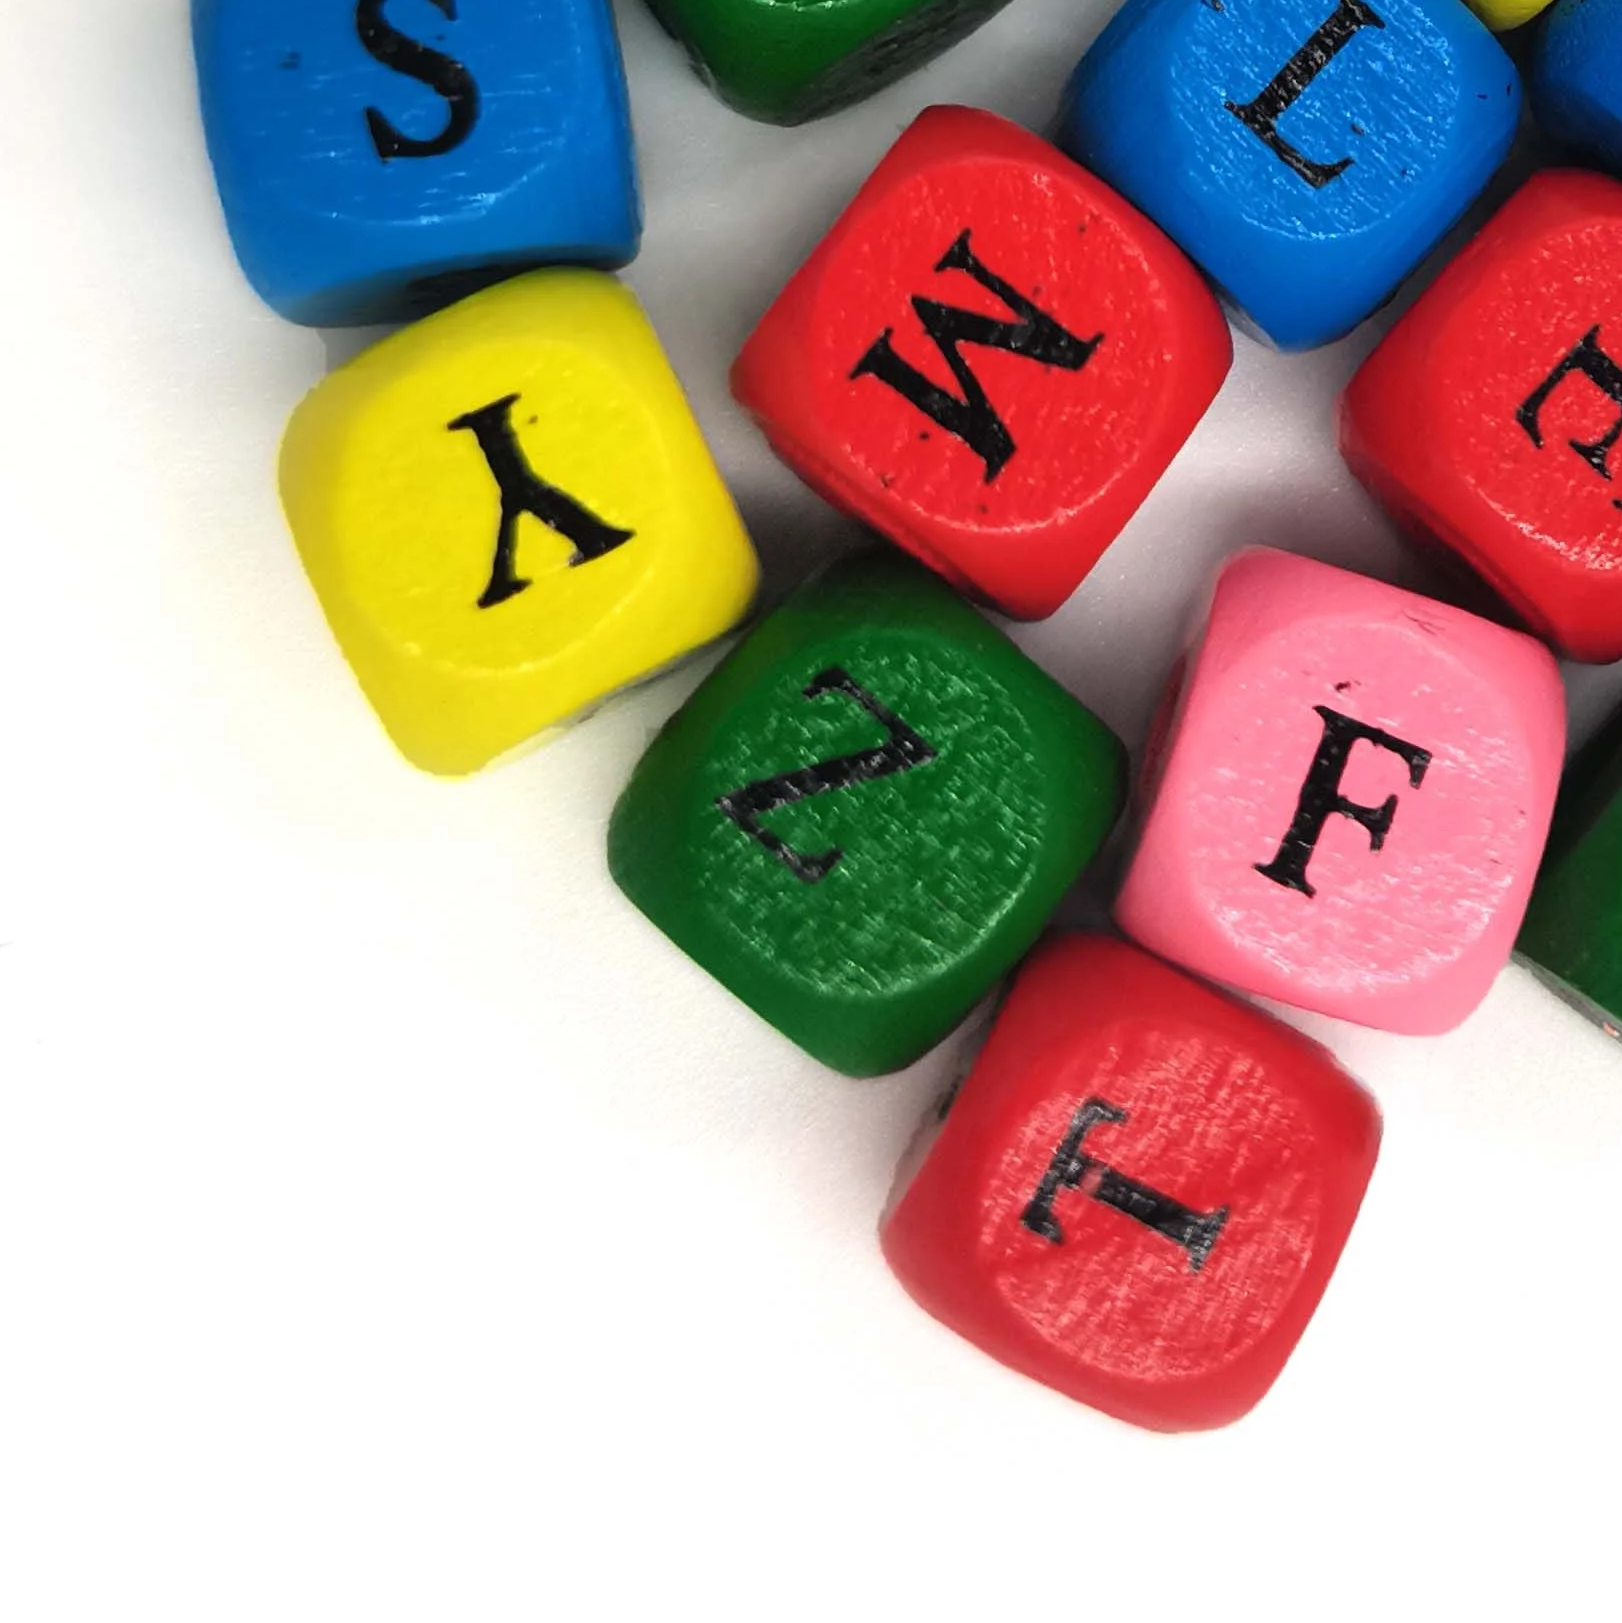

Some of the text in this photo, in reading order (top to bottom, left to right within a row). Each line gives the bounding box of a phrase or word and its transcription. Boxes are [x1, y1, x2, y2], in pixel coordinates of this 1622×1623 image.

[849, 227, 1105, 484] M
[448, 394, 634, 609] Y
[713, 666, 938, 885] Z
[1252, 705, 1433, 899] F
[1019, 1095, 1231, 1274] T
